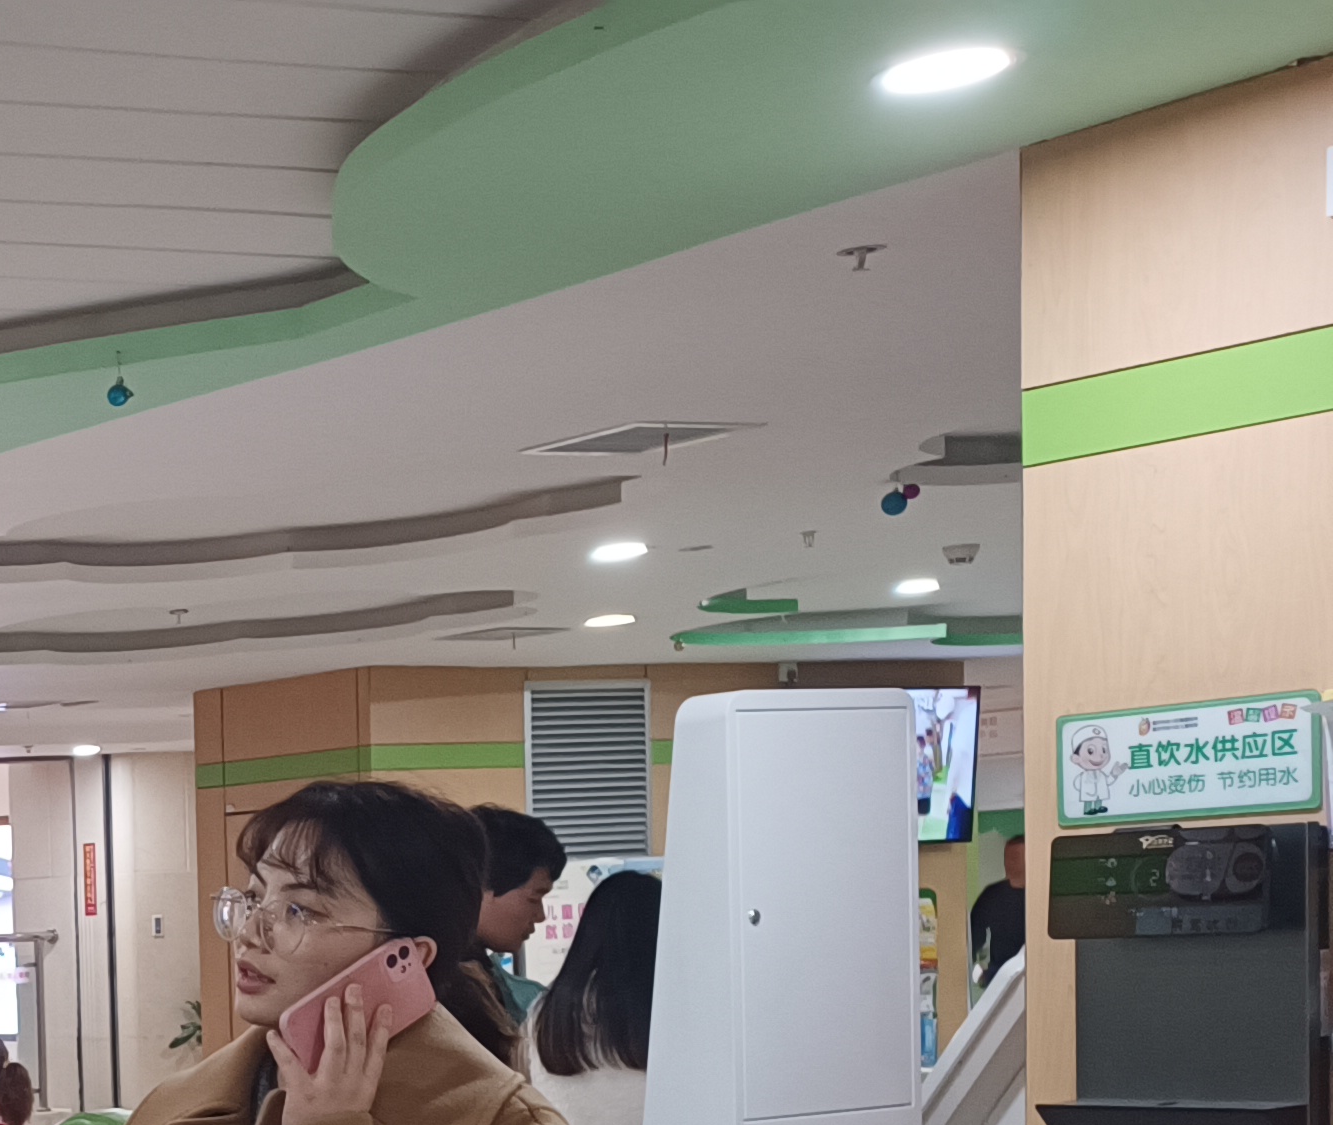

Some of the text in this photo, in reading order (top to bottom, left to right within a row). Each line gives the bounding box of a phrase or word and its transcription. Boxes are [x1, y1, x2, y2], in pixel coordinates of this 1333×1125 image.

[1128, 729, 1298, 770] 直饮水供应区
[1128, 766, 1299, 798] 小心烫伤 节约用水
